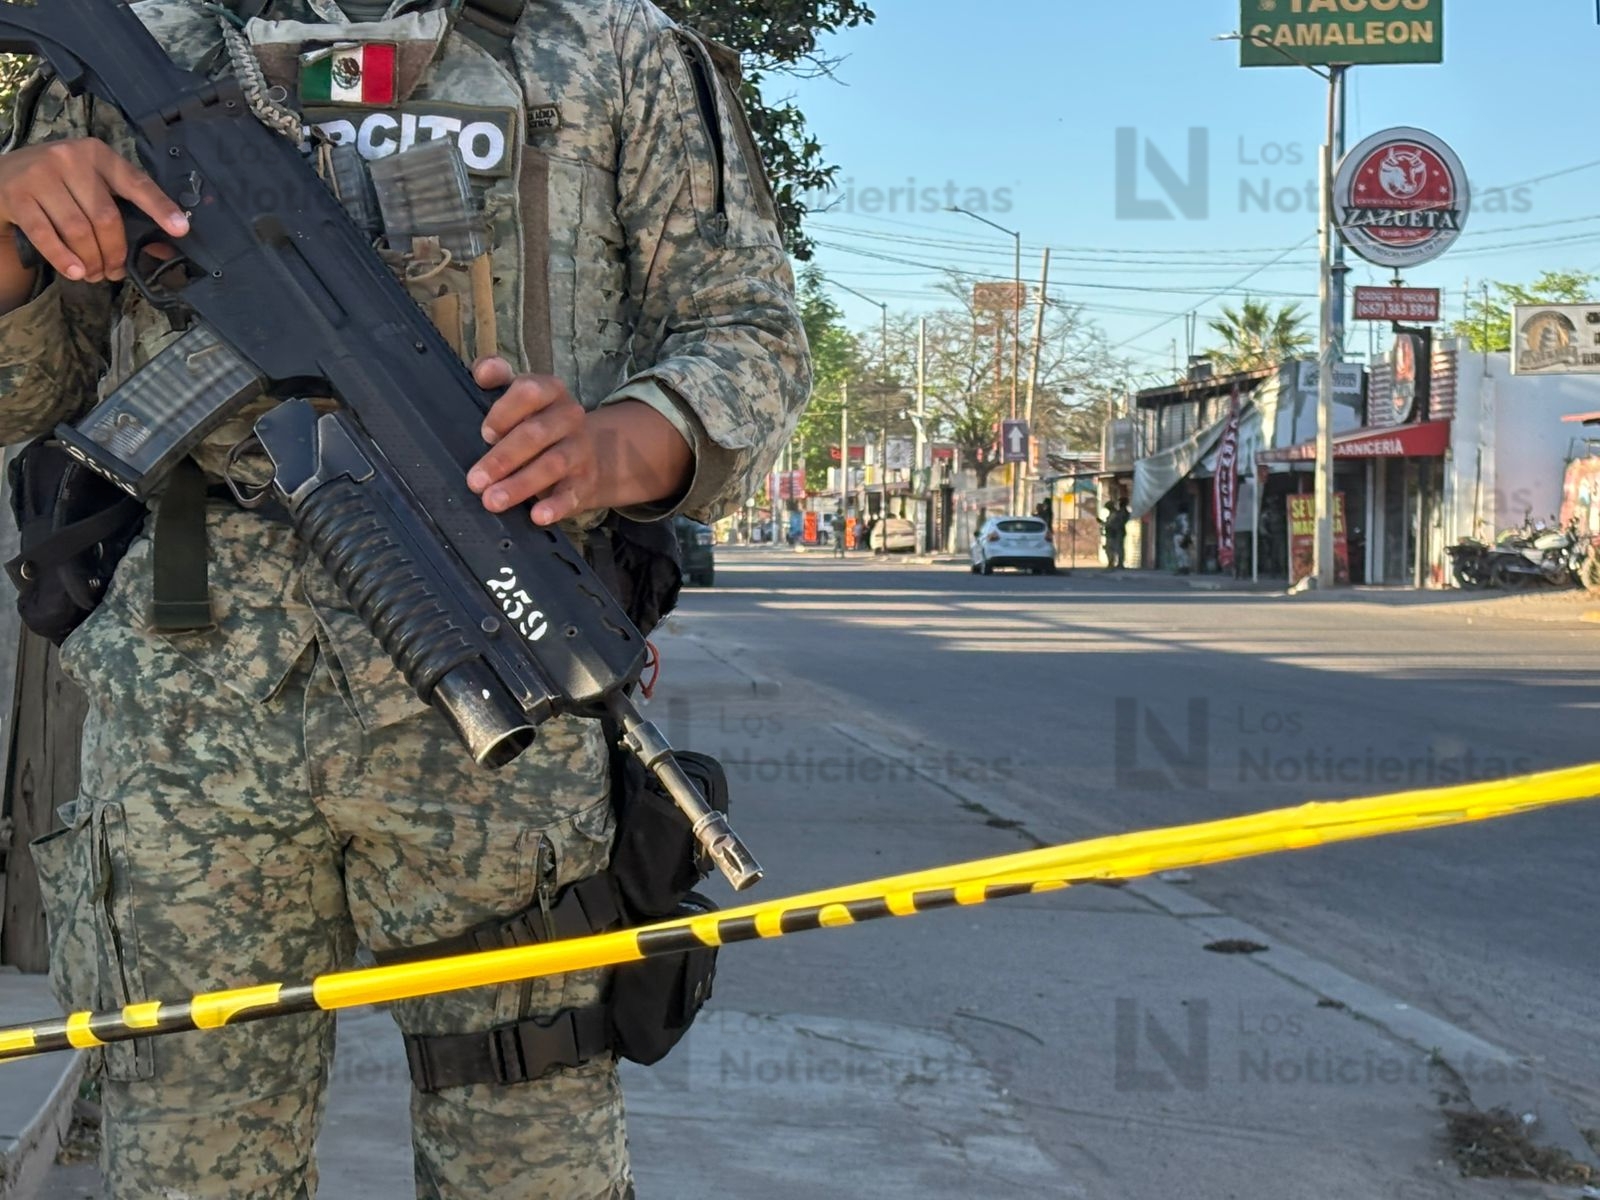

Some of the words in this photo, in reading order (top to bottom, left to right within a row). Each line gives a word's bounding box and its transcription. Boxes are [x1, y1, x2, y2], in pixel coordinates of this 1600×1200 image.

[1250, 21, 1434, 47] CAMALEON
[1346, 208, 1456, 229] ZAZUETA
[486, 567, 548, 641] 259
